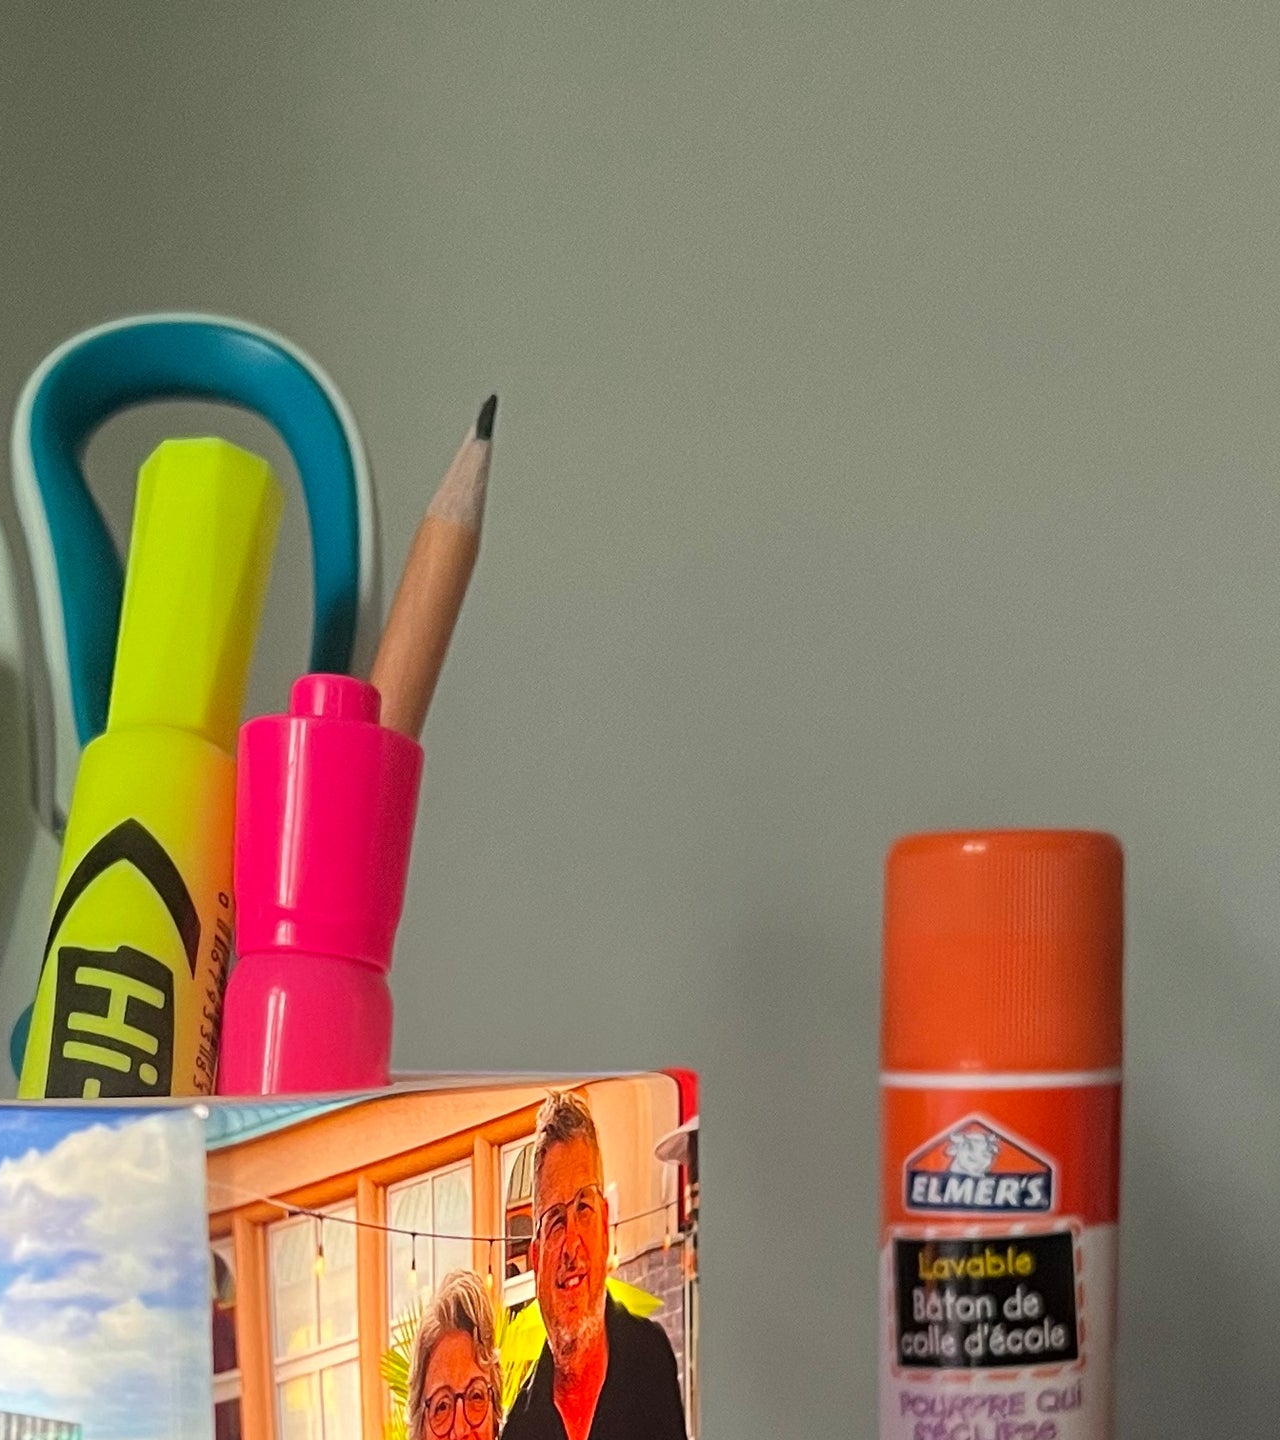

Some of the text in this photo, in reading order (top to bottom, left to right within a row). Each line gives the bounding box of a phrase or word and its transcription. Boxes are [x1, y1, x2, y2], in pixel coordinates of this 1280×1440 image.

[911, 1174, 1044, 1207] ELMER'S
[918, 1245, 1035, 1281] Lavable
[1003, 1284, 1040, 1320] de
[902, 1323, 956, 1356] colle
